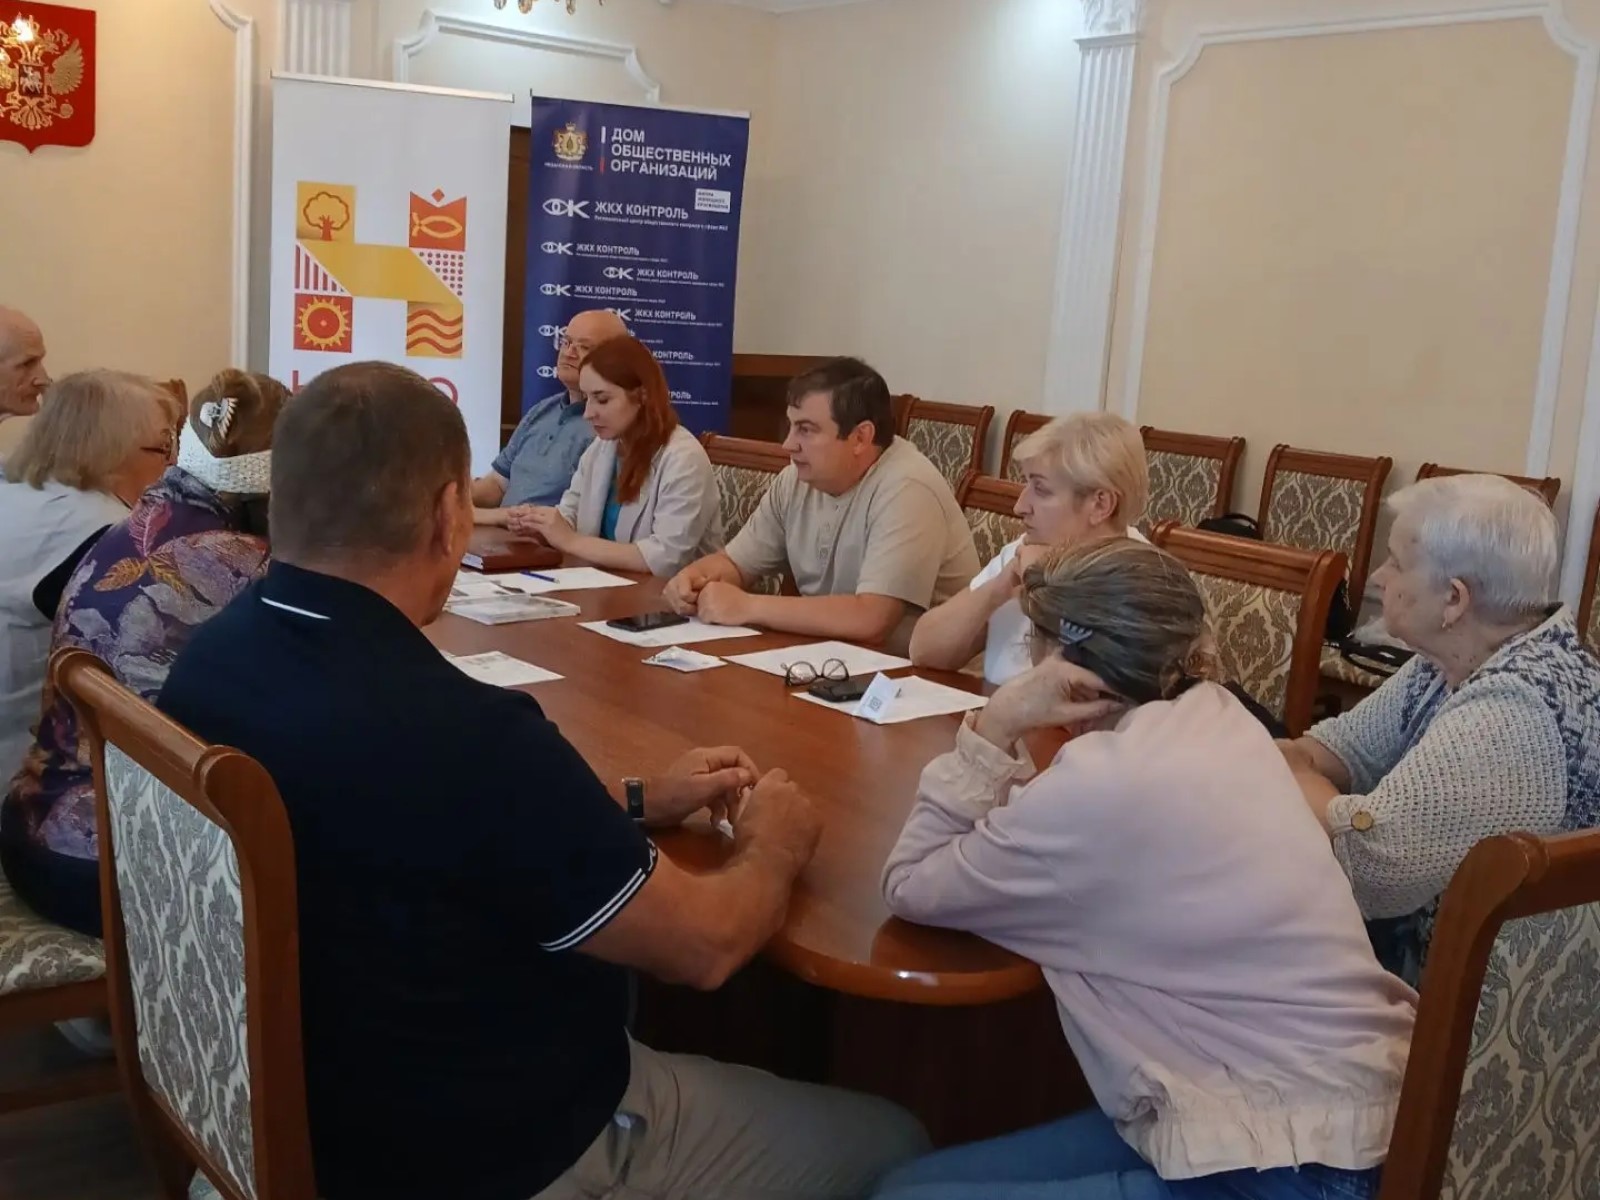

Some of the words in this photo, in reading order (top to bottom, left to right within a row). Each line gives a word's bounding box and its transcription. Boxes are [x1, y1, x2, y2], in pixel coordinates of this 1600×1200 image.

[611, 128, 645, 144] ДОМ
[611, 144, 732, 167] ОБЩЕСТВЕННЫХ
[610, 159, 718, 182] ОРГАНИЗАЦИЙ
[594, 201, 623, 215] ЖКХ
[626, 203, 689, 221] КОНТРОЛЬ
[576, 243, 595, 254] ЖКХ
[597, 244, 640, 256] КОНТРОЛЬ
[637, 268, 655, 278] ЖКХ
[657, 269, 699, 281] КОНТРОЛЬ
[574, 284, 593, 295] ЖКХ
[595, 285, 638, 297] КОНТРОЛЬ
[634, 308, 653, 319] ЖКХ
[654, 309, 697, 321] КОНТРОЛЬ
[653, 350, 694, 361] КОНТРОЛЬ
